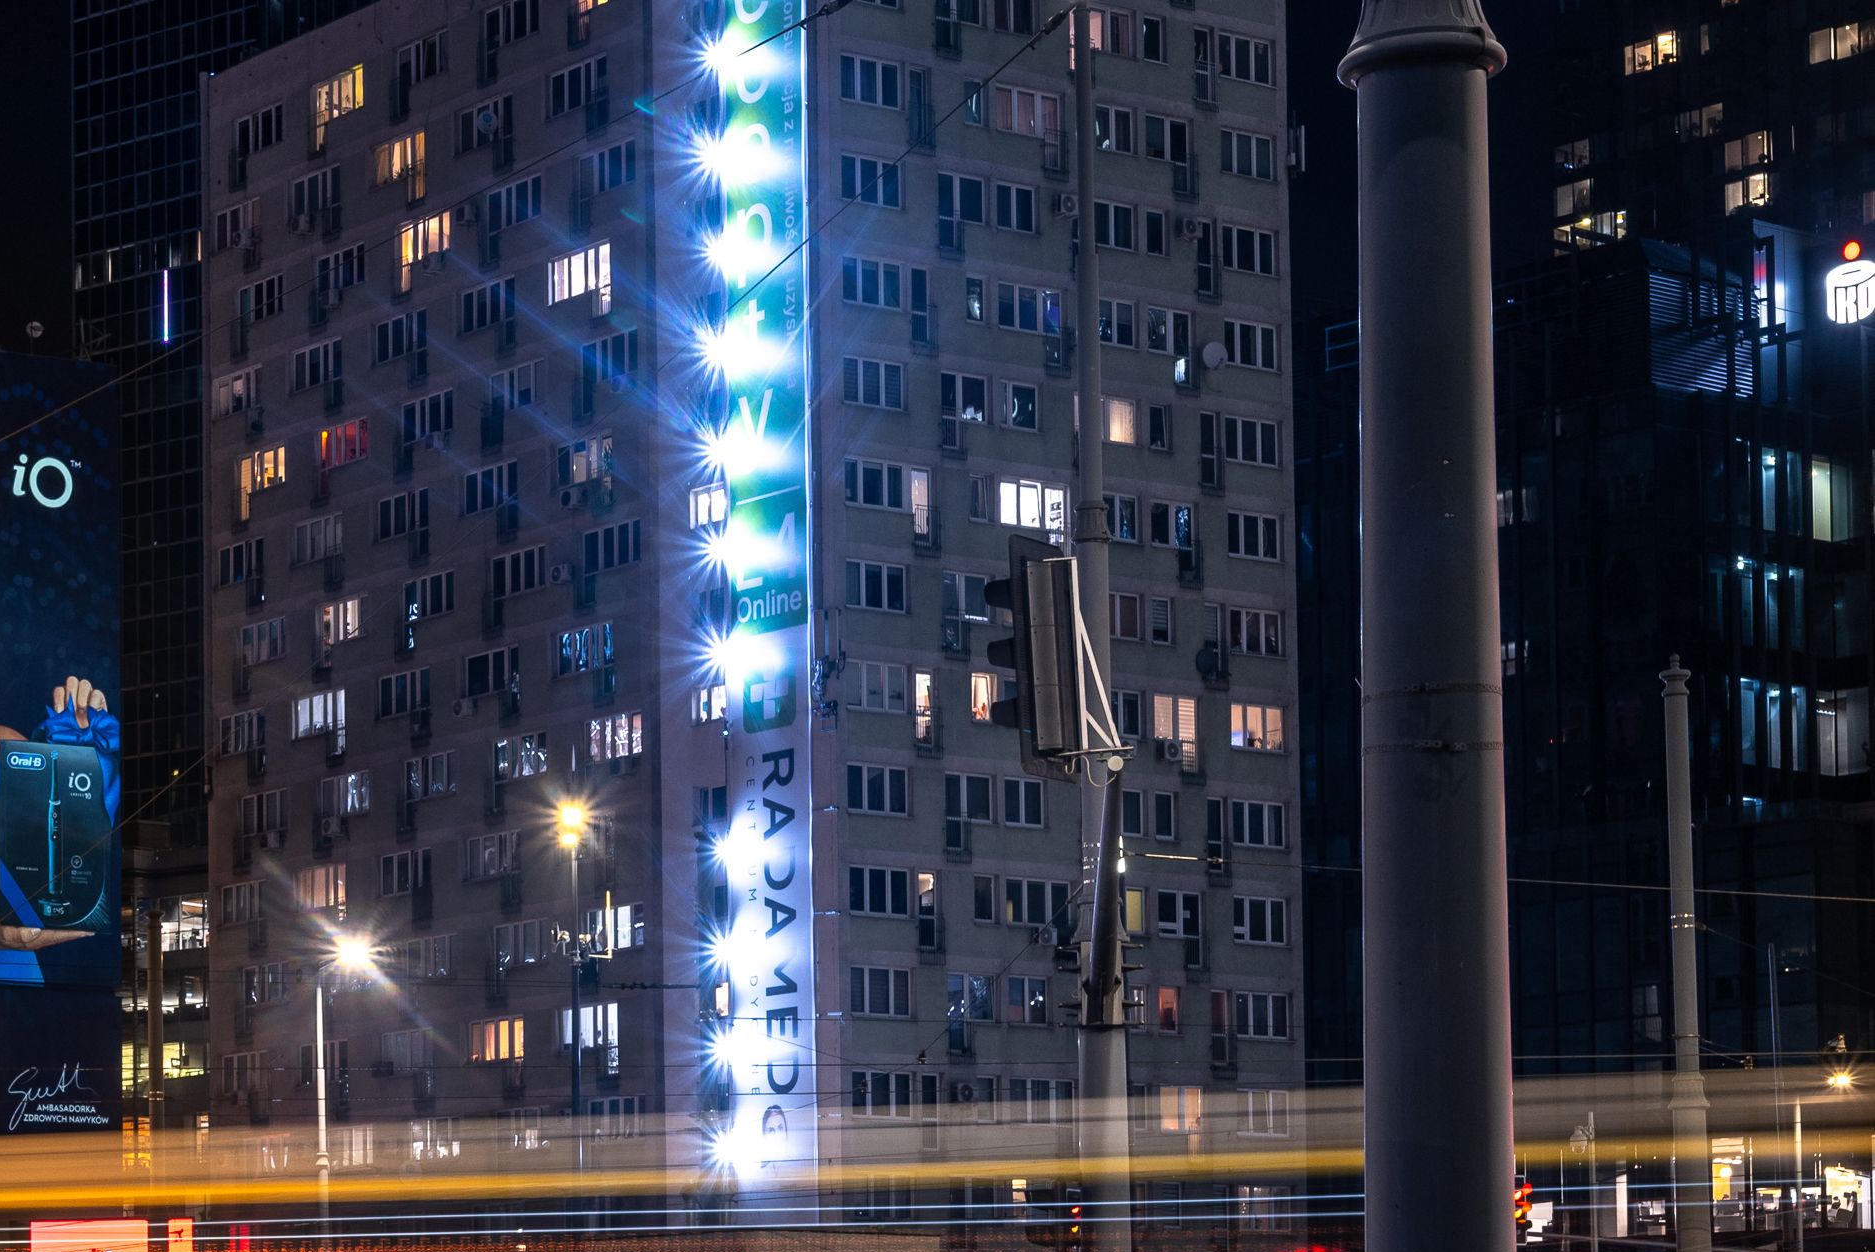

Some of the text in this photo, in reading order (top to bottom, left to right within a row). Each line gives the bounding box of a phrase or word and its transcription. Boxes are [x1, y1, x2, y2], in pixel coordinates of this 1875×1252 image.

[736, 588, 802, 624] Online
[10, 755, 42, 768] Oral-B
[36, 1103, 96, 1113] AMBASADORKA
[23, 1113, 110, 1125] ZDROWYCH NAWYKÓW
